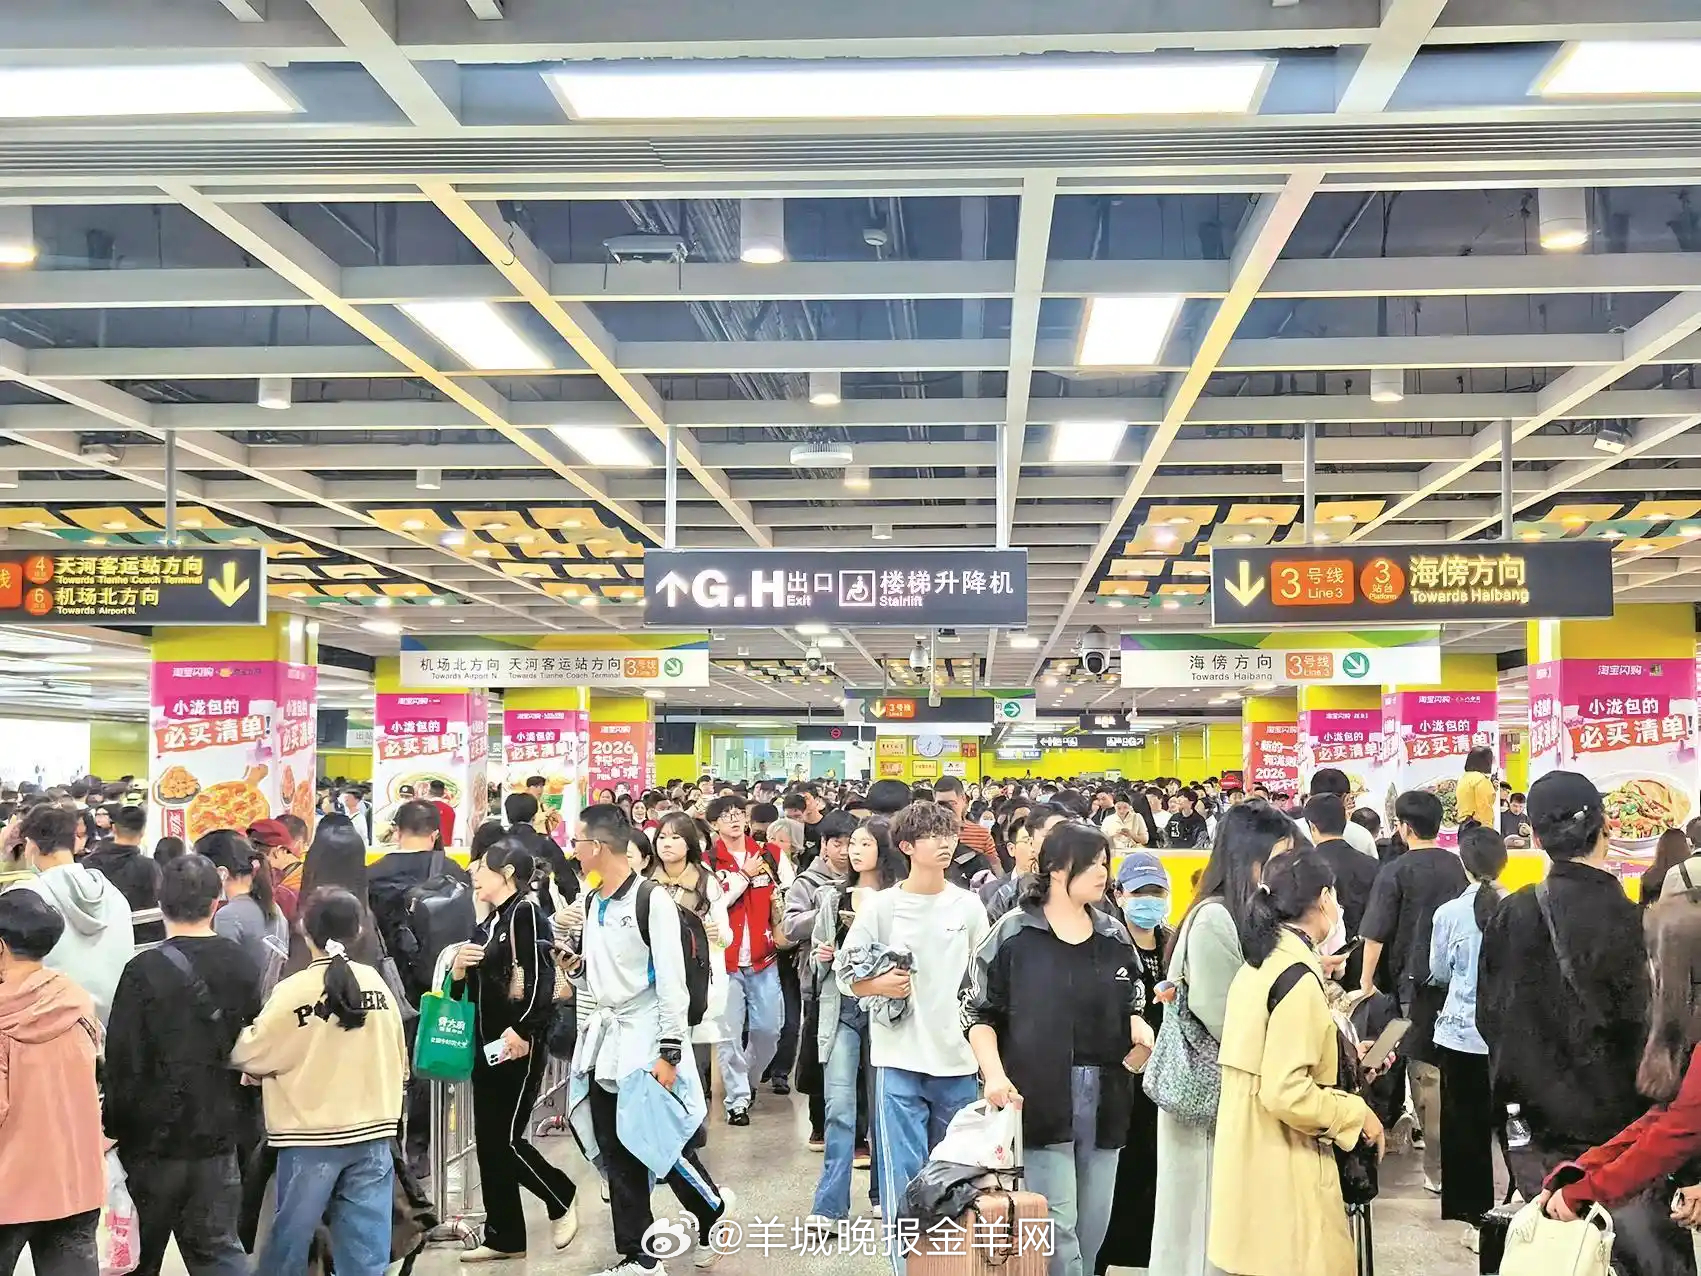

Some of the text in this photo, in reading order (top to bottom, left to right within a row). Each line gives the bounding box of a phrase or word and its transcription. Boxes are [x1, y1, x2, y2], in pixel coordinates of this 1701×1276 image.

[36, 557, 45, 573] 4
[56, 556, 203, 575] 天河客运站方向
[1375, 560, 1391, 584] 3
[1409, 554, 1526, 587] 海傍方向
[57, 576, 95, 585] Towards
[99, 576, 128, 585] Tianhe
[132, 576, 161, 585] Coach
[164, 576, 203, 585] Terminal
[787, 571, 833, 593] 出口
[880, 570, 1014, 596] 楼梯升降机
[1280, 567, 1301, 599] 3
[1307, 567, 1344, 584] 号线
[35, 588, 44, 602] 6
[56, 587, 159, 606] 机场北方向
[691, 569, 784, 608] G.H
[1372, 584, 1393, 593] 站台
[1410, 588, 1530, 605] Towards Haibang
[787, 595, 811, 607] Exit
[880, 595, 923, 608] Stairlift
[57, 606, 95, 615] Towards
[99, 606, 127, 616] Airport
[420, 657, 620, 671] 机场北方向 天河客运站方向
[1189, 654, 1272, 670] 海傍方向
[1289, 655, 1303, 676] 3
[1304, 656, 1329, 668] 号线
[1598, 664, 1642, 676] 淘宝闪购
[465, 673, 489, 681] Airport
[509, 672, 620, 680] Towards Tianhe Coach Terminal
[1191, 672, 1273, 681] Towards Haibang
[172, 698, 240, 716] 小泷包的
[1588, 697, 1659, 716] 小泷包的
[1419, 719, 1470, 732] 小泷包的
[591, 740, 634, 755] 2026
[1254, 767, 1287, 780] 2026
[293, 990, 389, 1028] POER
